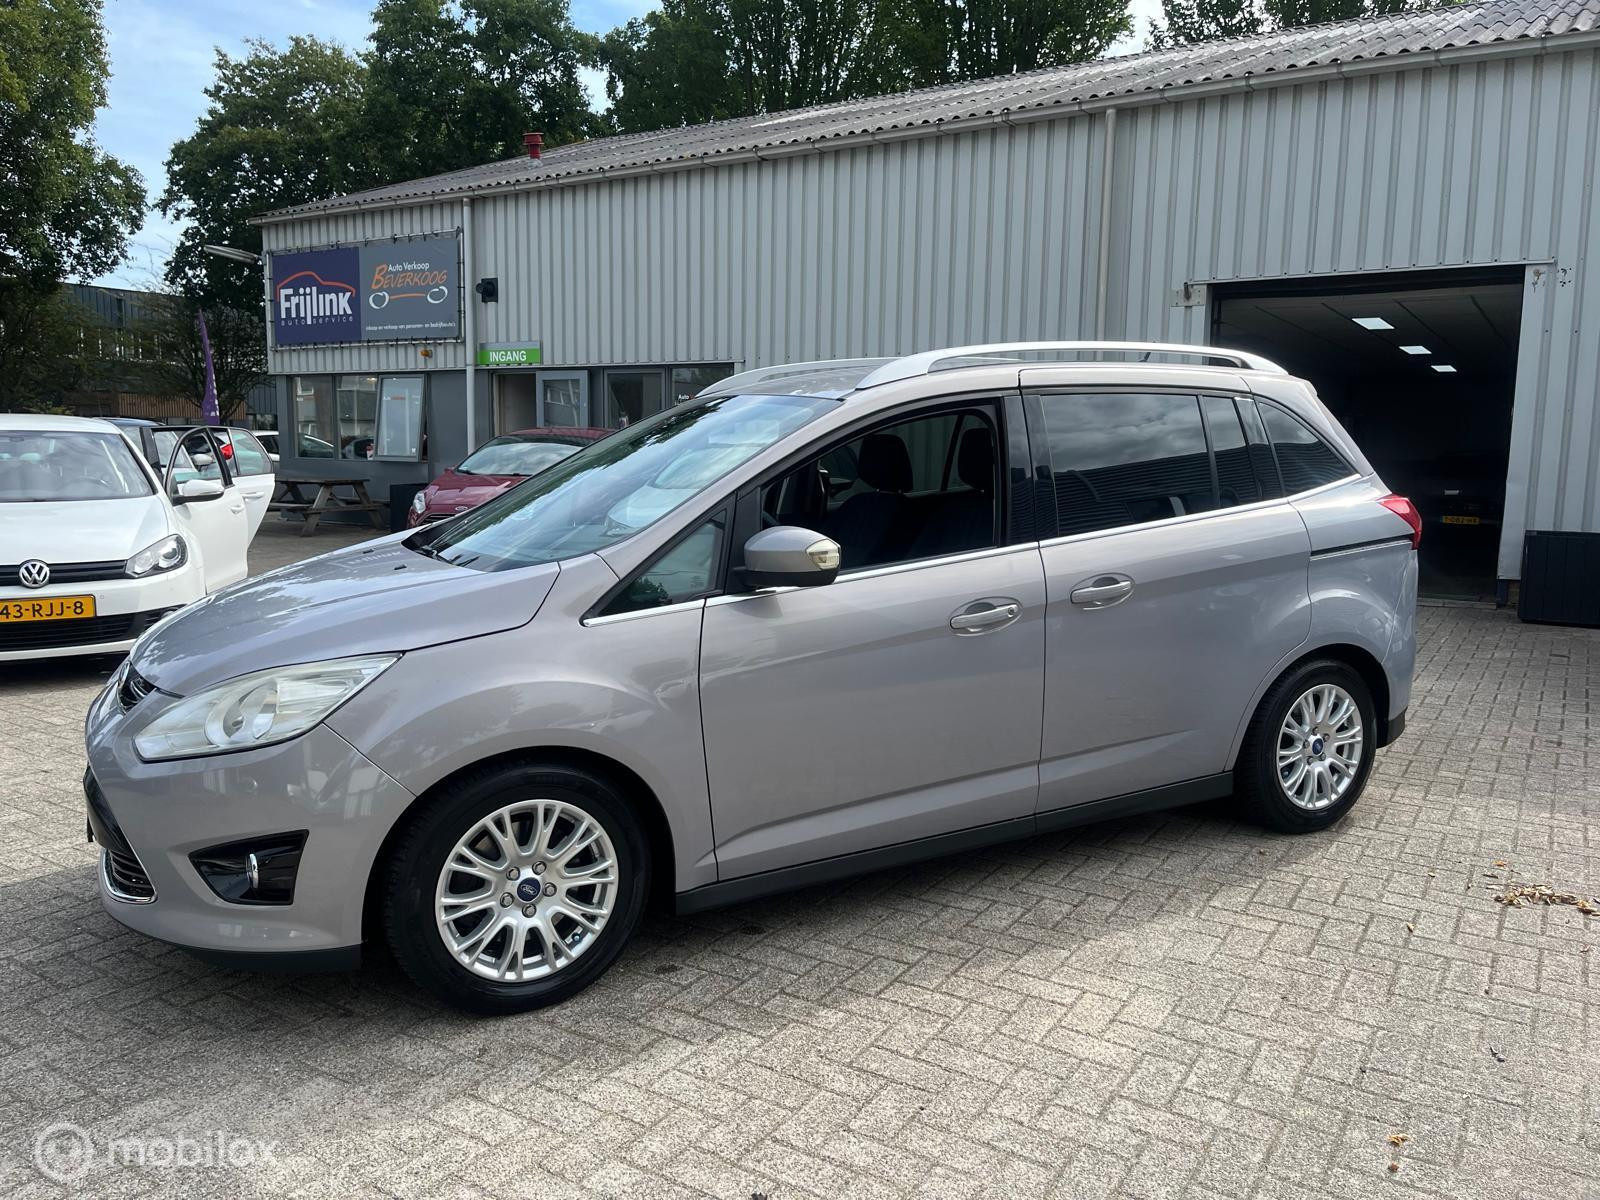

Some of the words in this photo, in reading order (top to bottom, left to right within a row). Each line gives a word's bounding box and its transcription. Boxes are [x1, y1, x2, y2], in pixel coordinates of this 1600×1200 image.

[388, 263, 403, 272] Auto
[403, 260, 430, 273] Verkoop
[371, 264, 447, 290] BEVERKOOG
[281, 319, 306, 327] auto
[312, 316, 354, 326] service
[489, 350, 527, 363] INGANG
[0, 600, 85, 619] 43-RJJ-8
